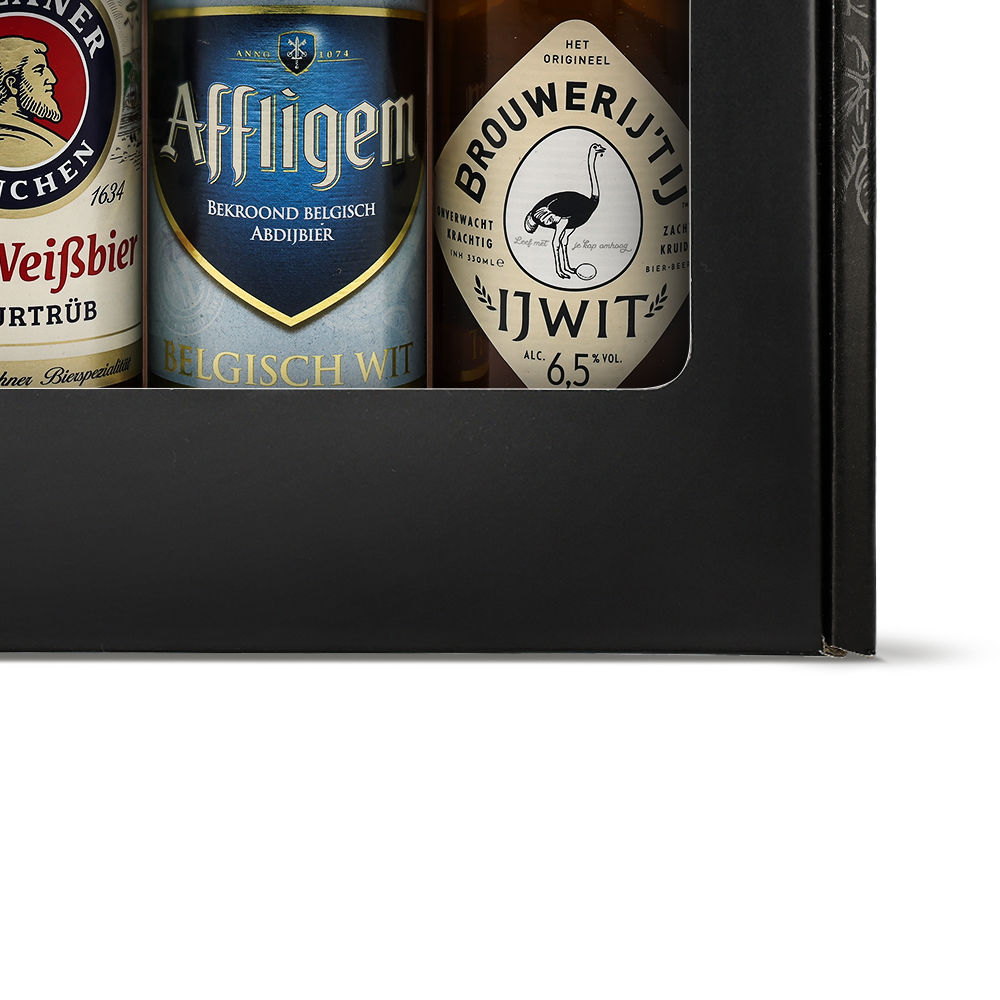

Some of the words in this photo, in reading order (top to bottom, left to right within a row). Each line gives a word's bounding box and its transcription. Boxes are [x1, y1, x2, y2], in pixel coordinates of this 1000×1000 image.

[235, 50, 271, 59] ANNO
[318, 49, 350, 59] 1074
[565, 38, 590, 50] HET
[543, 53, 610, 66] ORIGINEEL
[160, 80, 418, 191] Affligem
[90, 180, 125, 208] 1634
[207, 199, 299, 221] BEKROOND
[303, 200, 376, 220] BELGISCH
[436, 205, 494, 231] ONVERWACHT
[250, 226, 334, 246] ABDIJBIER
[446, 227, 493, 249] KRACHTIG
[450, 249, 463, 259] INH
[498, 288, 650, 342] IJWIT
[163, 338, 344, 389] BELGISCH
[355, 341, 414, 384] WIT
[523, 350, 546, 361] ALC.
[39, 356, 132, 387] Bierspezialität
